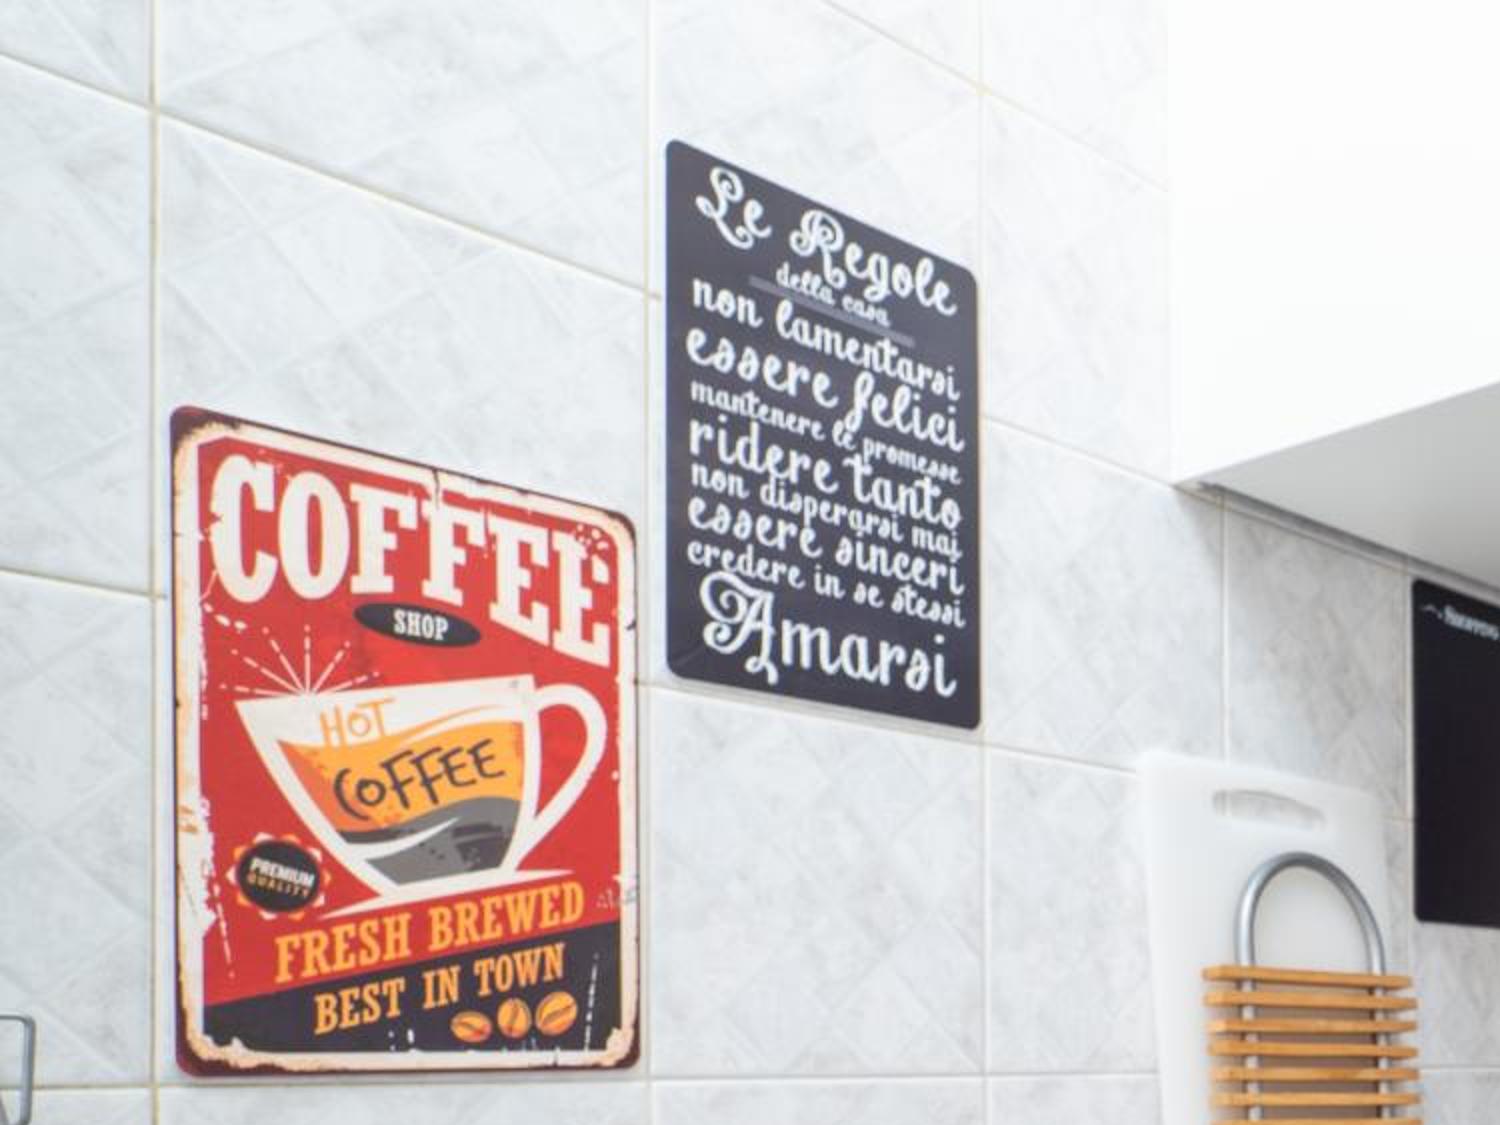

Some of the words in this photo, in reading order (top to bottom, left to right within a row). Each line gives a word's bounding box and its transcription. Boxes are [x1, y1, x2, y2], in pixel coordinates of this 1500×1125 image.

[696, 166, 772, 250] Le
[789, 208, 957, 316] Regole
[692, 277, 763, 328] non
[776, 299, 960, 401] lamentarsi
[776, 262, 835, 307] della
[841, 294, 891, 328] casa
[686, 327, 839, 408] essere
[844, 370, 965, 452] felici
[690, 380, 825, 441] mantenere
[832, 419, 856, 451] le
[862, 437, 962, 485] promesse
[689, 415, 839, 493] ridere
[842, 453, 962, 529] tanto
[691, 463, 749, 499] non
[760, 474, 904, 543] disperarsi
[911, 525, 962, 559] mai
[209, 453, 611, 668] COFFEE
[688, 497, 823, 558] essere
[836, 531, 965, 596] sinceri
[688, 541, 806, 589] credere
[814, 565, 846, 599] in
[853, 582, 884, 608] se
[891, 583, 966, 628] stessi
[393, 608, 449, 641] SHOP
[700, 570, 957, 697] Amarsi
[249, 857, 316, 888] PREMIUM
[274, 912, 411, 985] FRESH
[428, 880, 584, 952] BREWED
[314, 978, 406, 1036] BEST
[422, 965, 461, 1010] IN
[473, 942, 565, 997] TOWN
